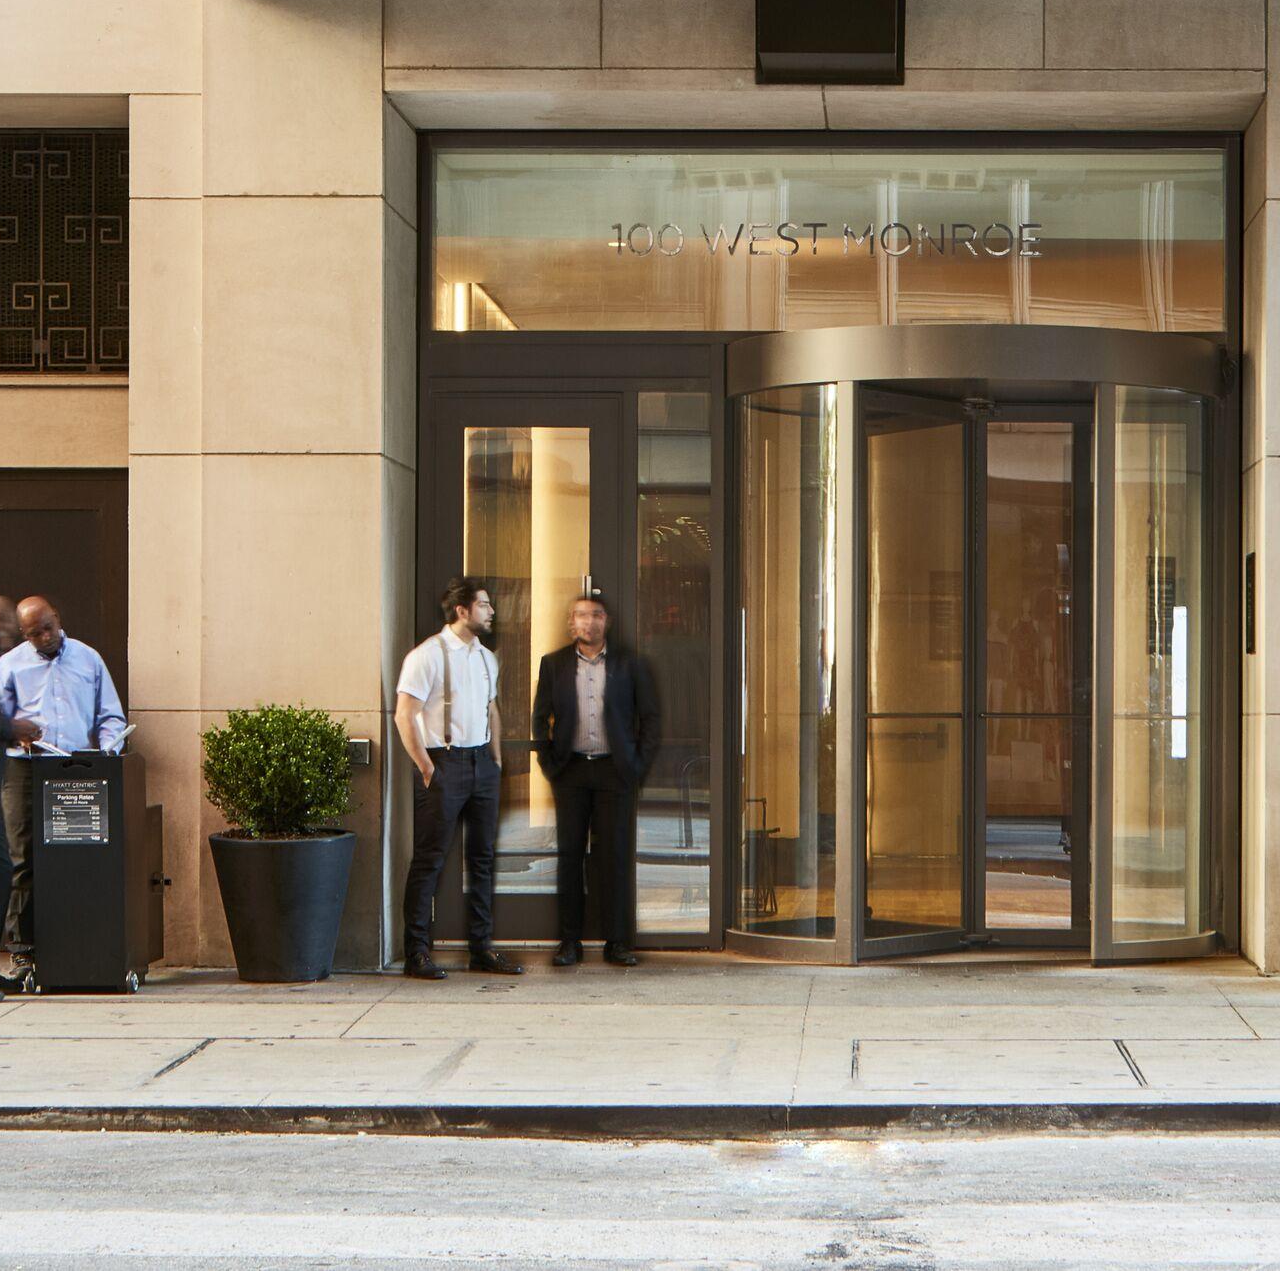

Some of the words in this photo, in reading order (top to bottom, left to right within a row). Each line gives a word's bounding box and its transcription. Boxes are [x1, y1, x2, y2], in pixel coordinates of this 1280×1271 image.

[610, 223, 685, 256] 100
[700, 223, 827, 256] WEST
[842, 223, 1043, 257] MONROE
